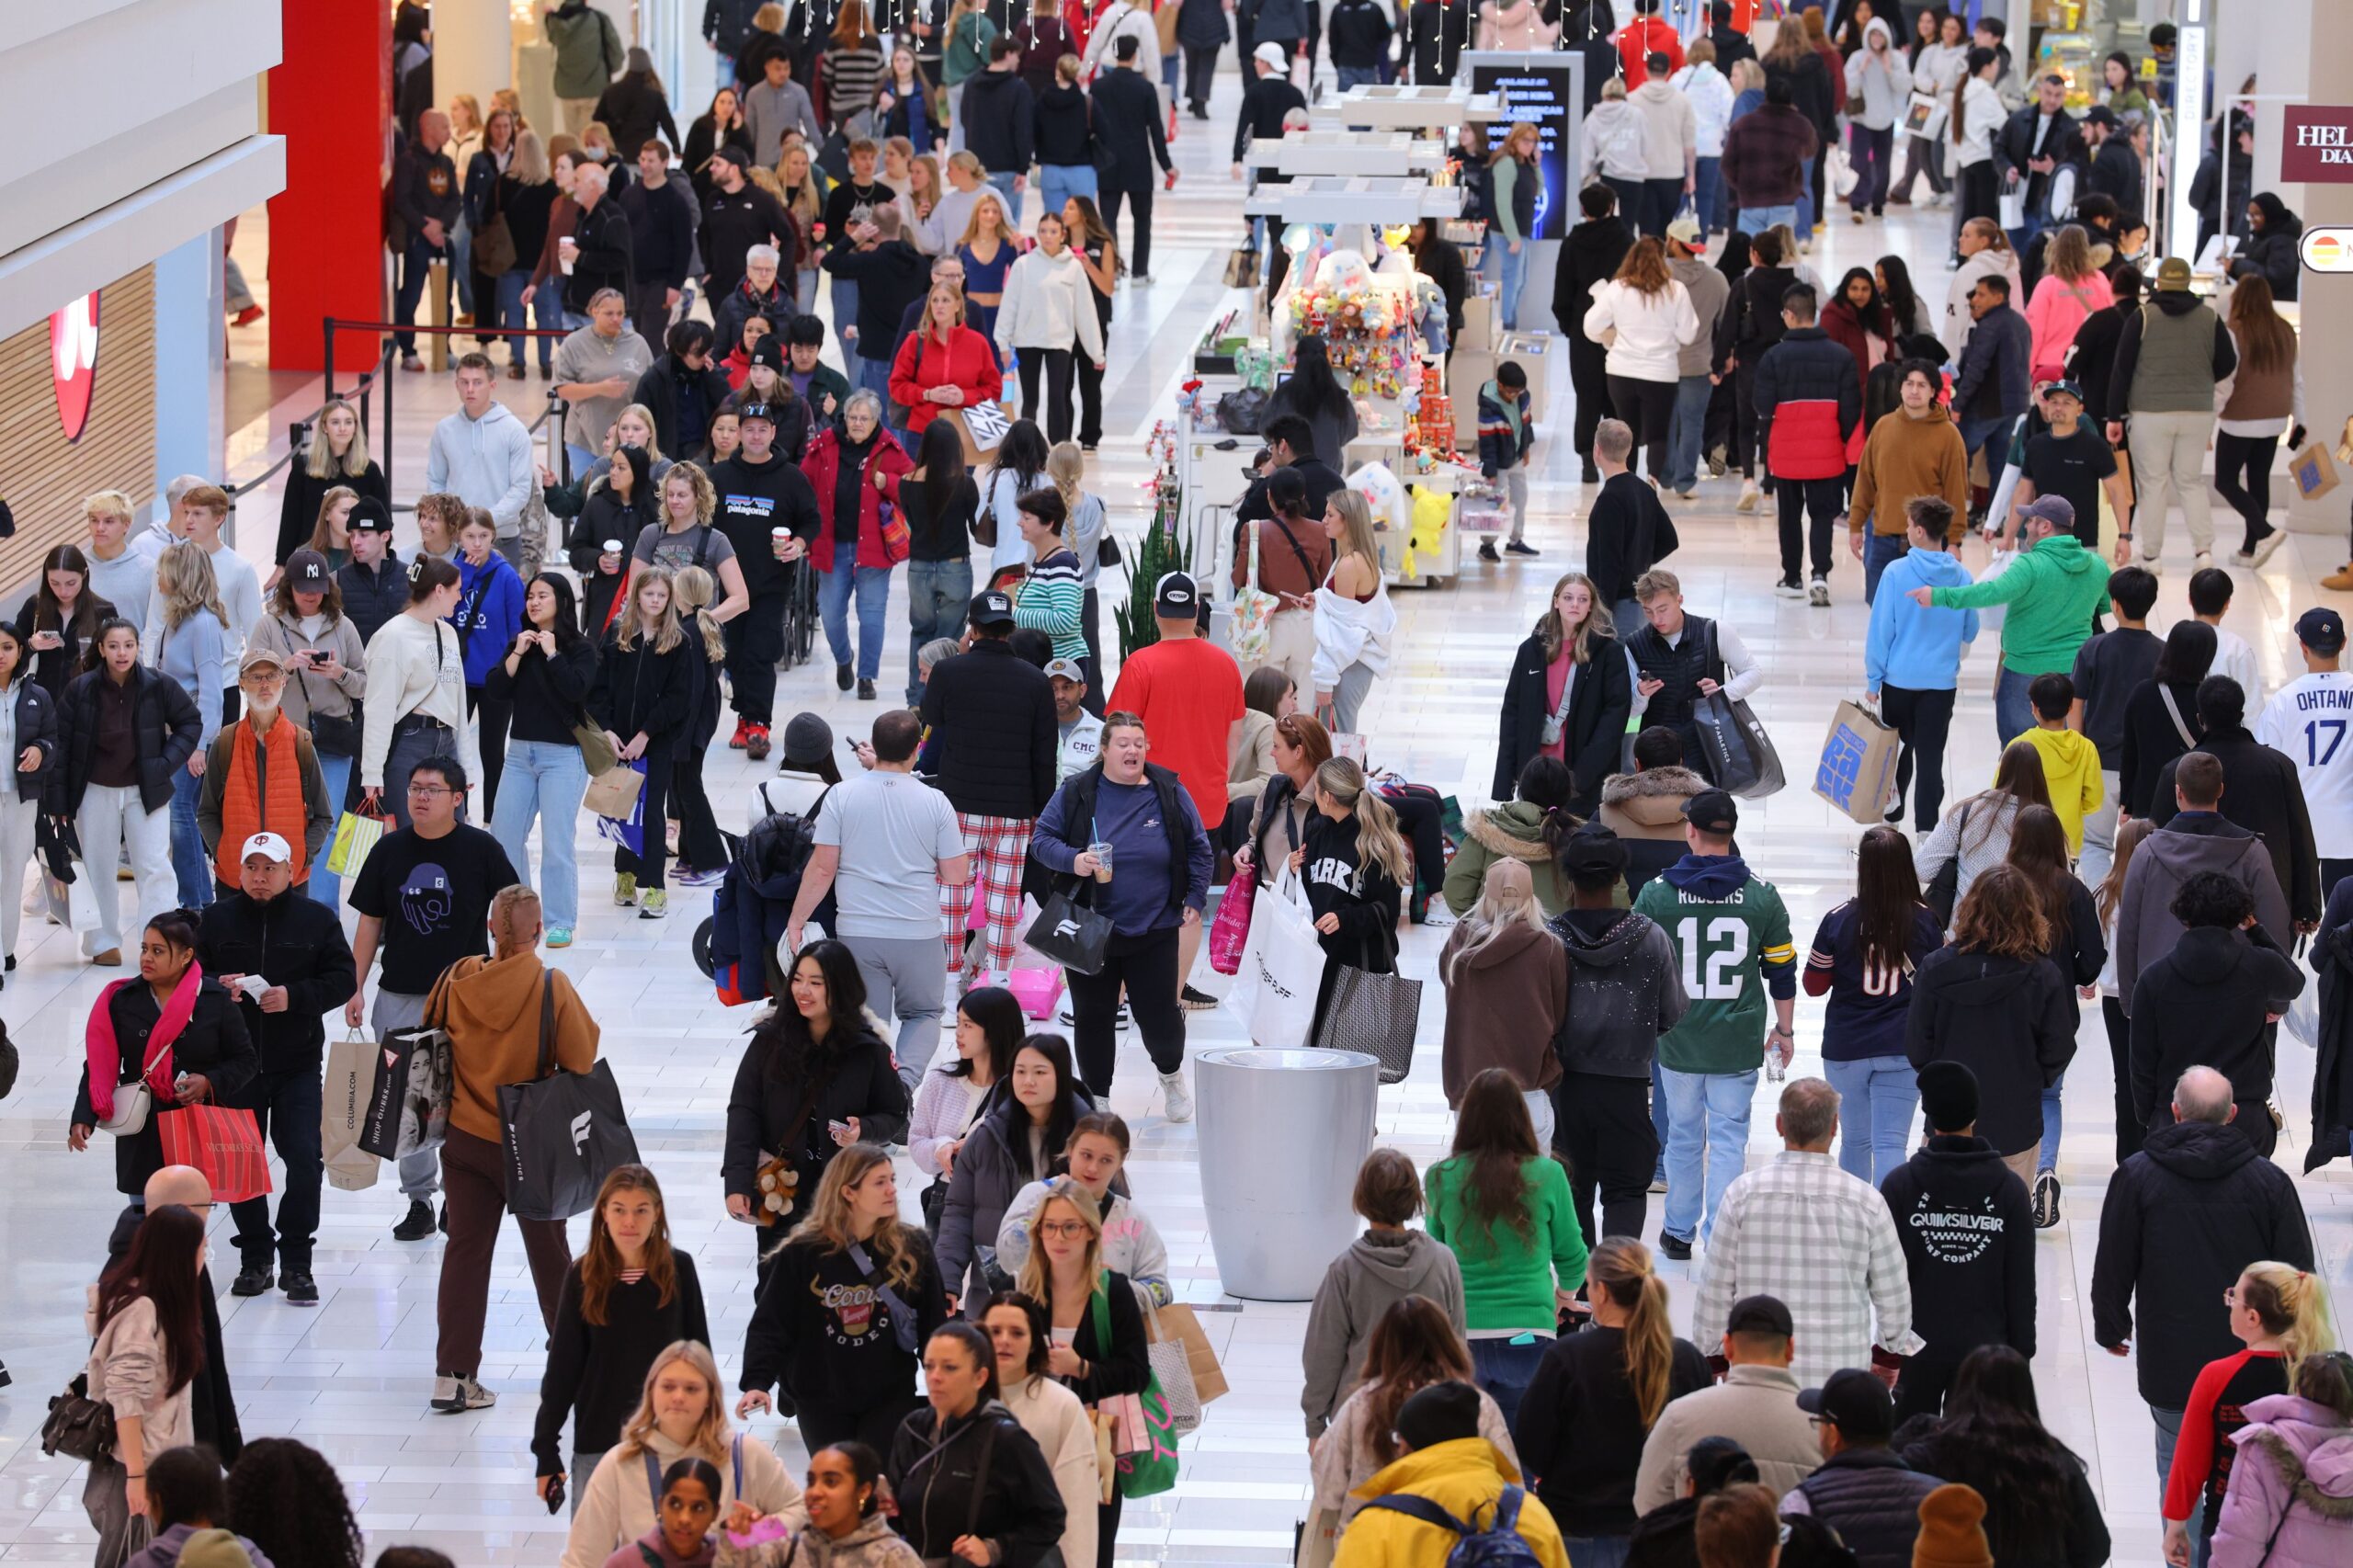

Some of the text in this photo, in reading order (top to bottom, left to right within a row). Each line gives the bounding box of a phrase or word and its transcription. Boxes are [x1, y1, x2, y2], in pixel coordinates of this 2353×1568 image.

[2184, 32, 2199, 120] DIRECTORY
[727, 506, 770, 517] patagonia
[2297, 690, 2353, 711] OHTANI
[1073, 742, 1096, 753] CMC
[1714, 726, 1731, 763] FABLETICS
[2304, 720, 2347, 767] 17
[1218, 912, 1246, 930] holiday
[1677, 917, 1749, 999] 12
[347, 1071, 357, 1131] COLUMBIA.COM
[371, 1121, 381, 1145] SHOP
[1909, 1212, 2004, 1233] QUIKSILVER
[1921, 1230, 1992, 1264] SURF COMPANY
[825, 1317, 889, 1346] RODEO
